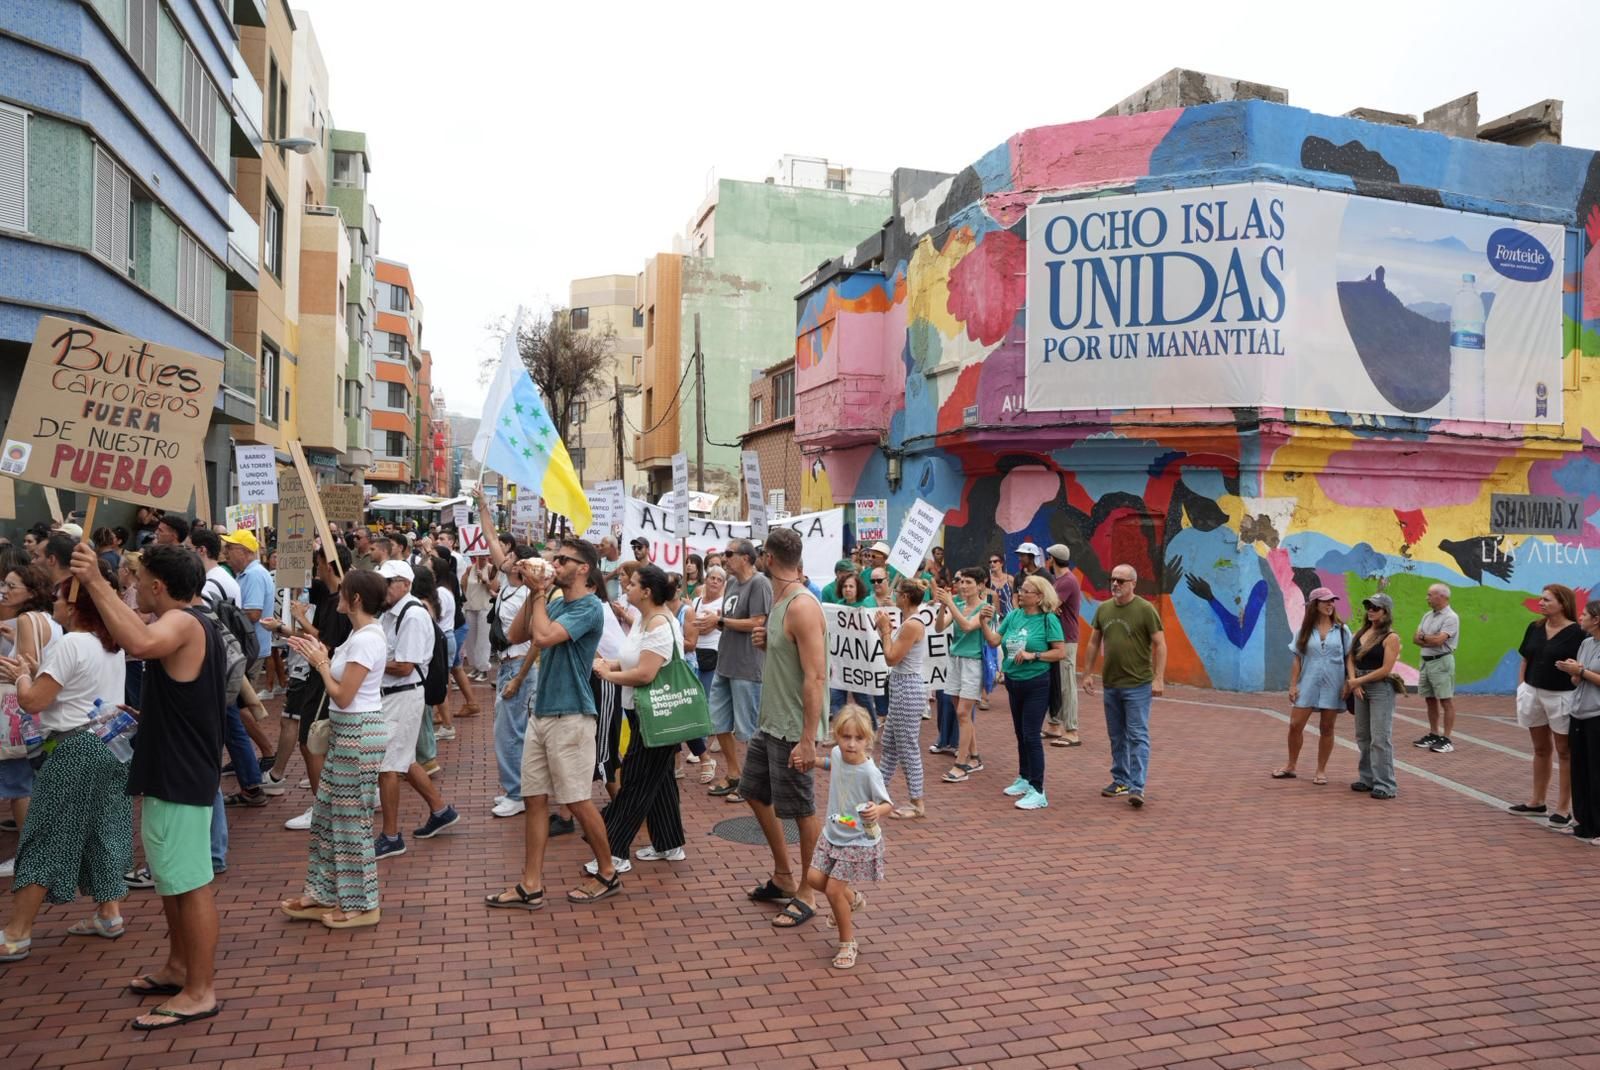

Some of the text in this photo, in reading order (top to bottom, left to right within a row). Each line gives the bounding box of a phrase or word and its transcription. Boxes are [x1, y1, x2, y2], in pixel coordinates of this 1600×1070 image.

[1045, 198, 1285, 255] OCHO ISLAS
[1495, 244, 1545, 265] Fonteide
[1045, 245, 1286, 330] UNIDAS
[51, 328, 201, 393] Buitres
[1043, 328, 1285, 363] POR UN MANANTIAL
[82, 400, 160, 433] FUERA
[33, 416, 180, 459] DE NUESTRO
[50, 443, 172, 499] PUEBLO
[1495, 500, 1579, 529] SHAWNA X
[899, 548, 911, 561] LPGC
[650, 687, 698, 703] Notting Hill
[652, 697, 692, 710] shopping
